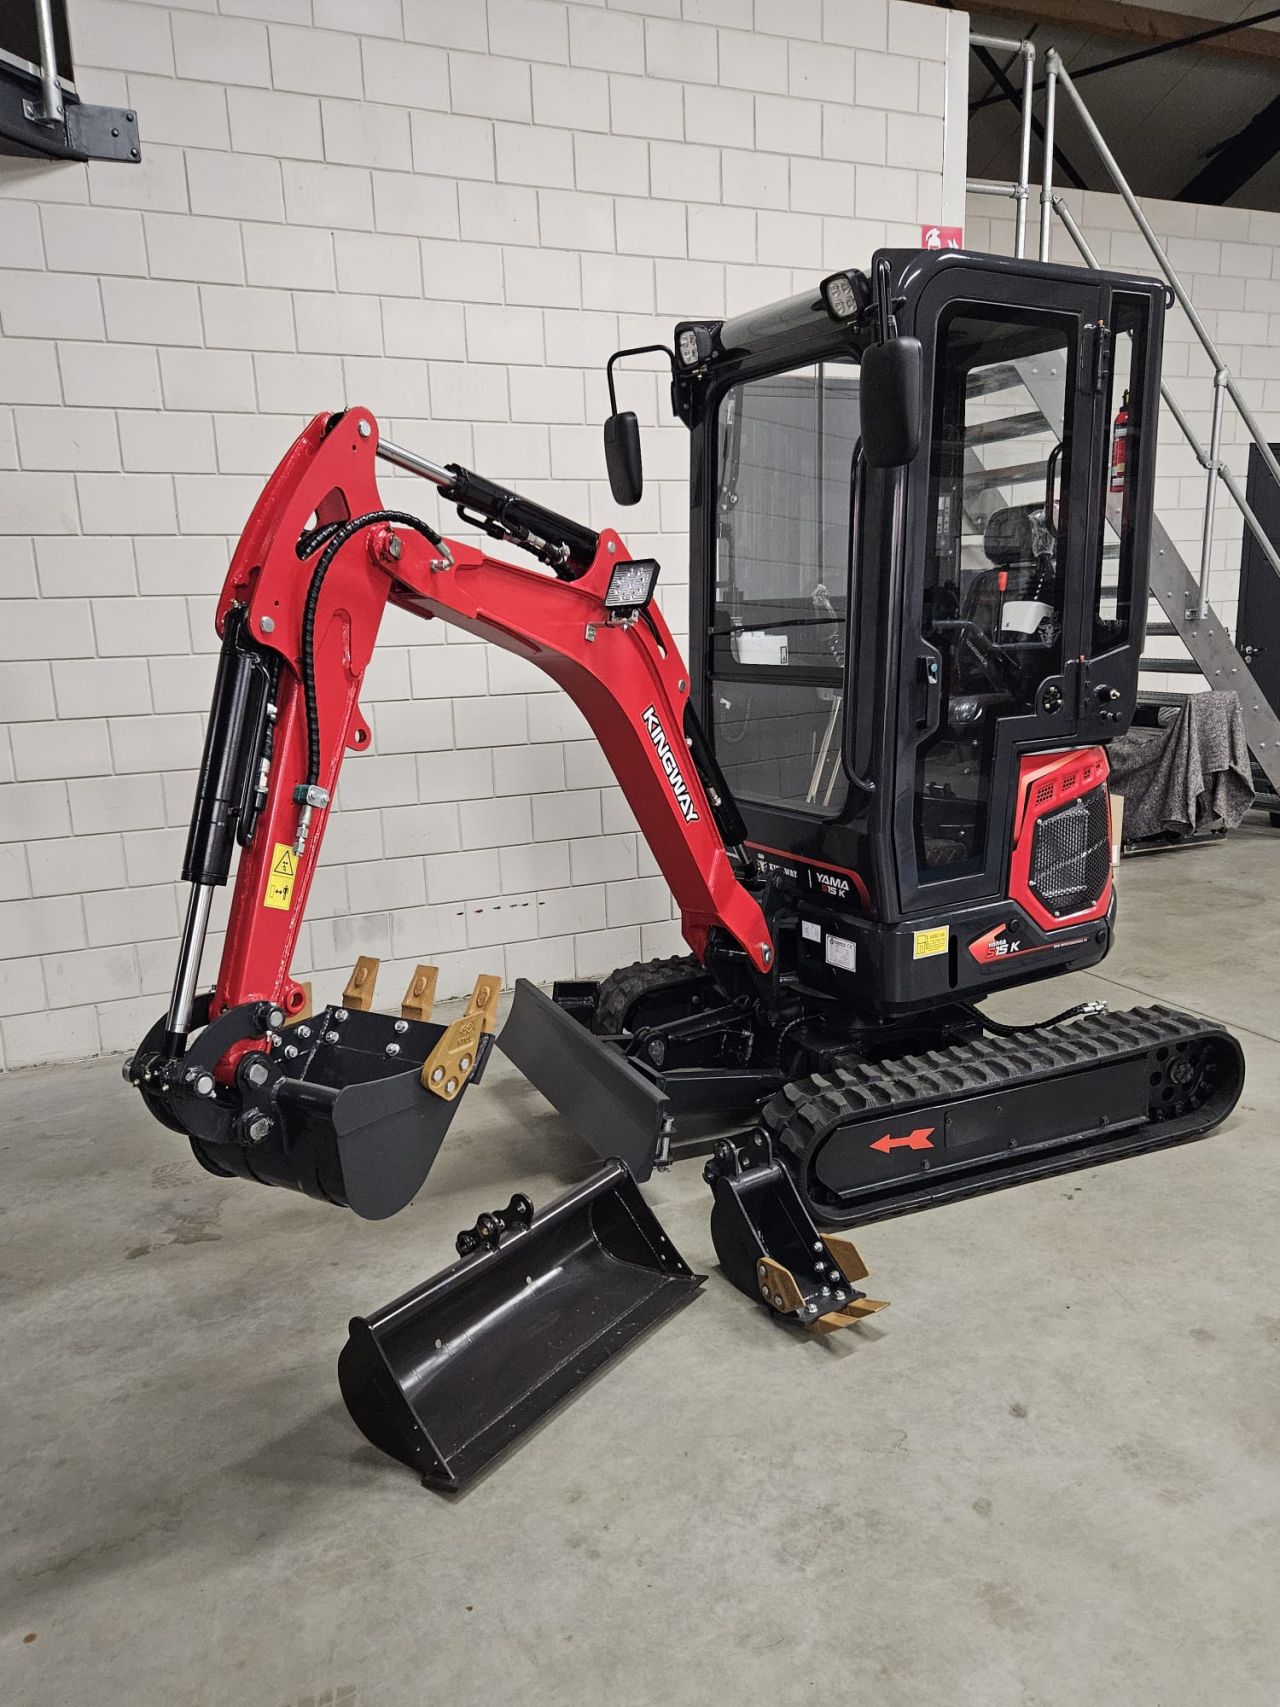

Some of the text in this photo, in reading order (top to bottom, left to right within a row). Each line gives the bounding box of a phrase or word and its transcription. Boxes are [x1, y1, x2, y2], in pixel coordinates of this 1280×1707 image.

[642, 706, 699, 822] KINGWAY
[816, 872, 849, 891] YAMA
[985, 940, 1021, 959] S15 K
